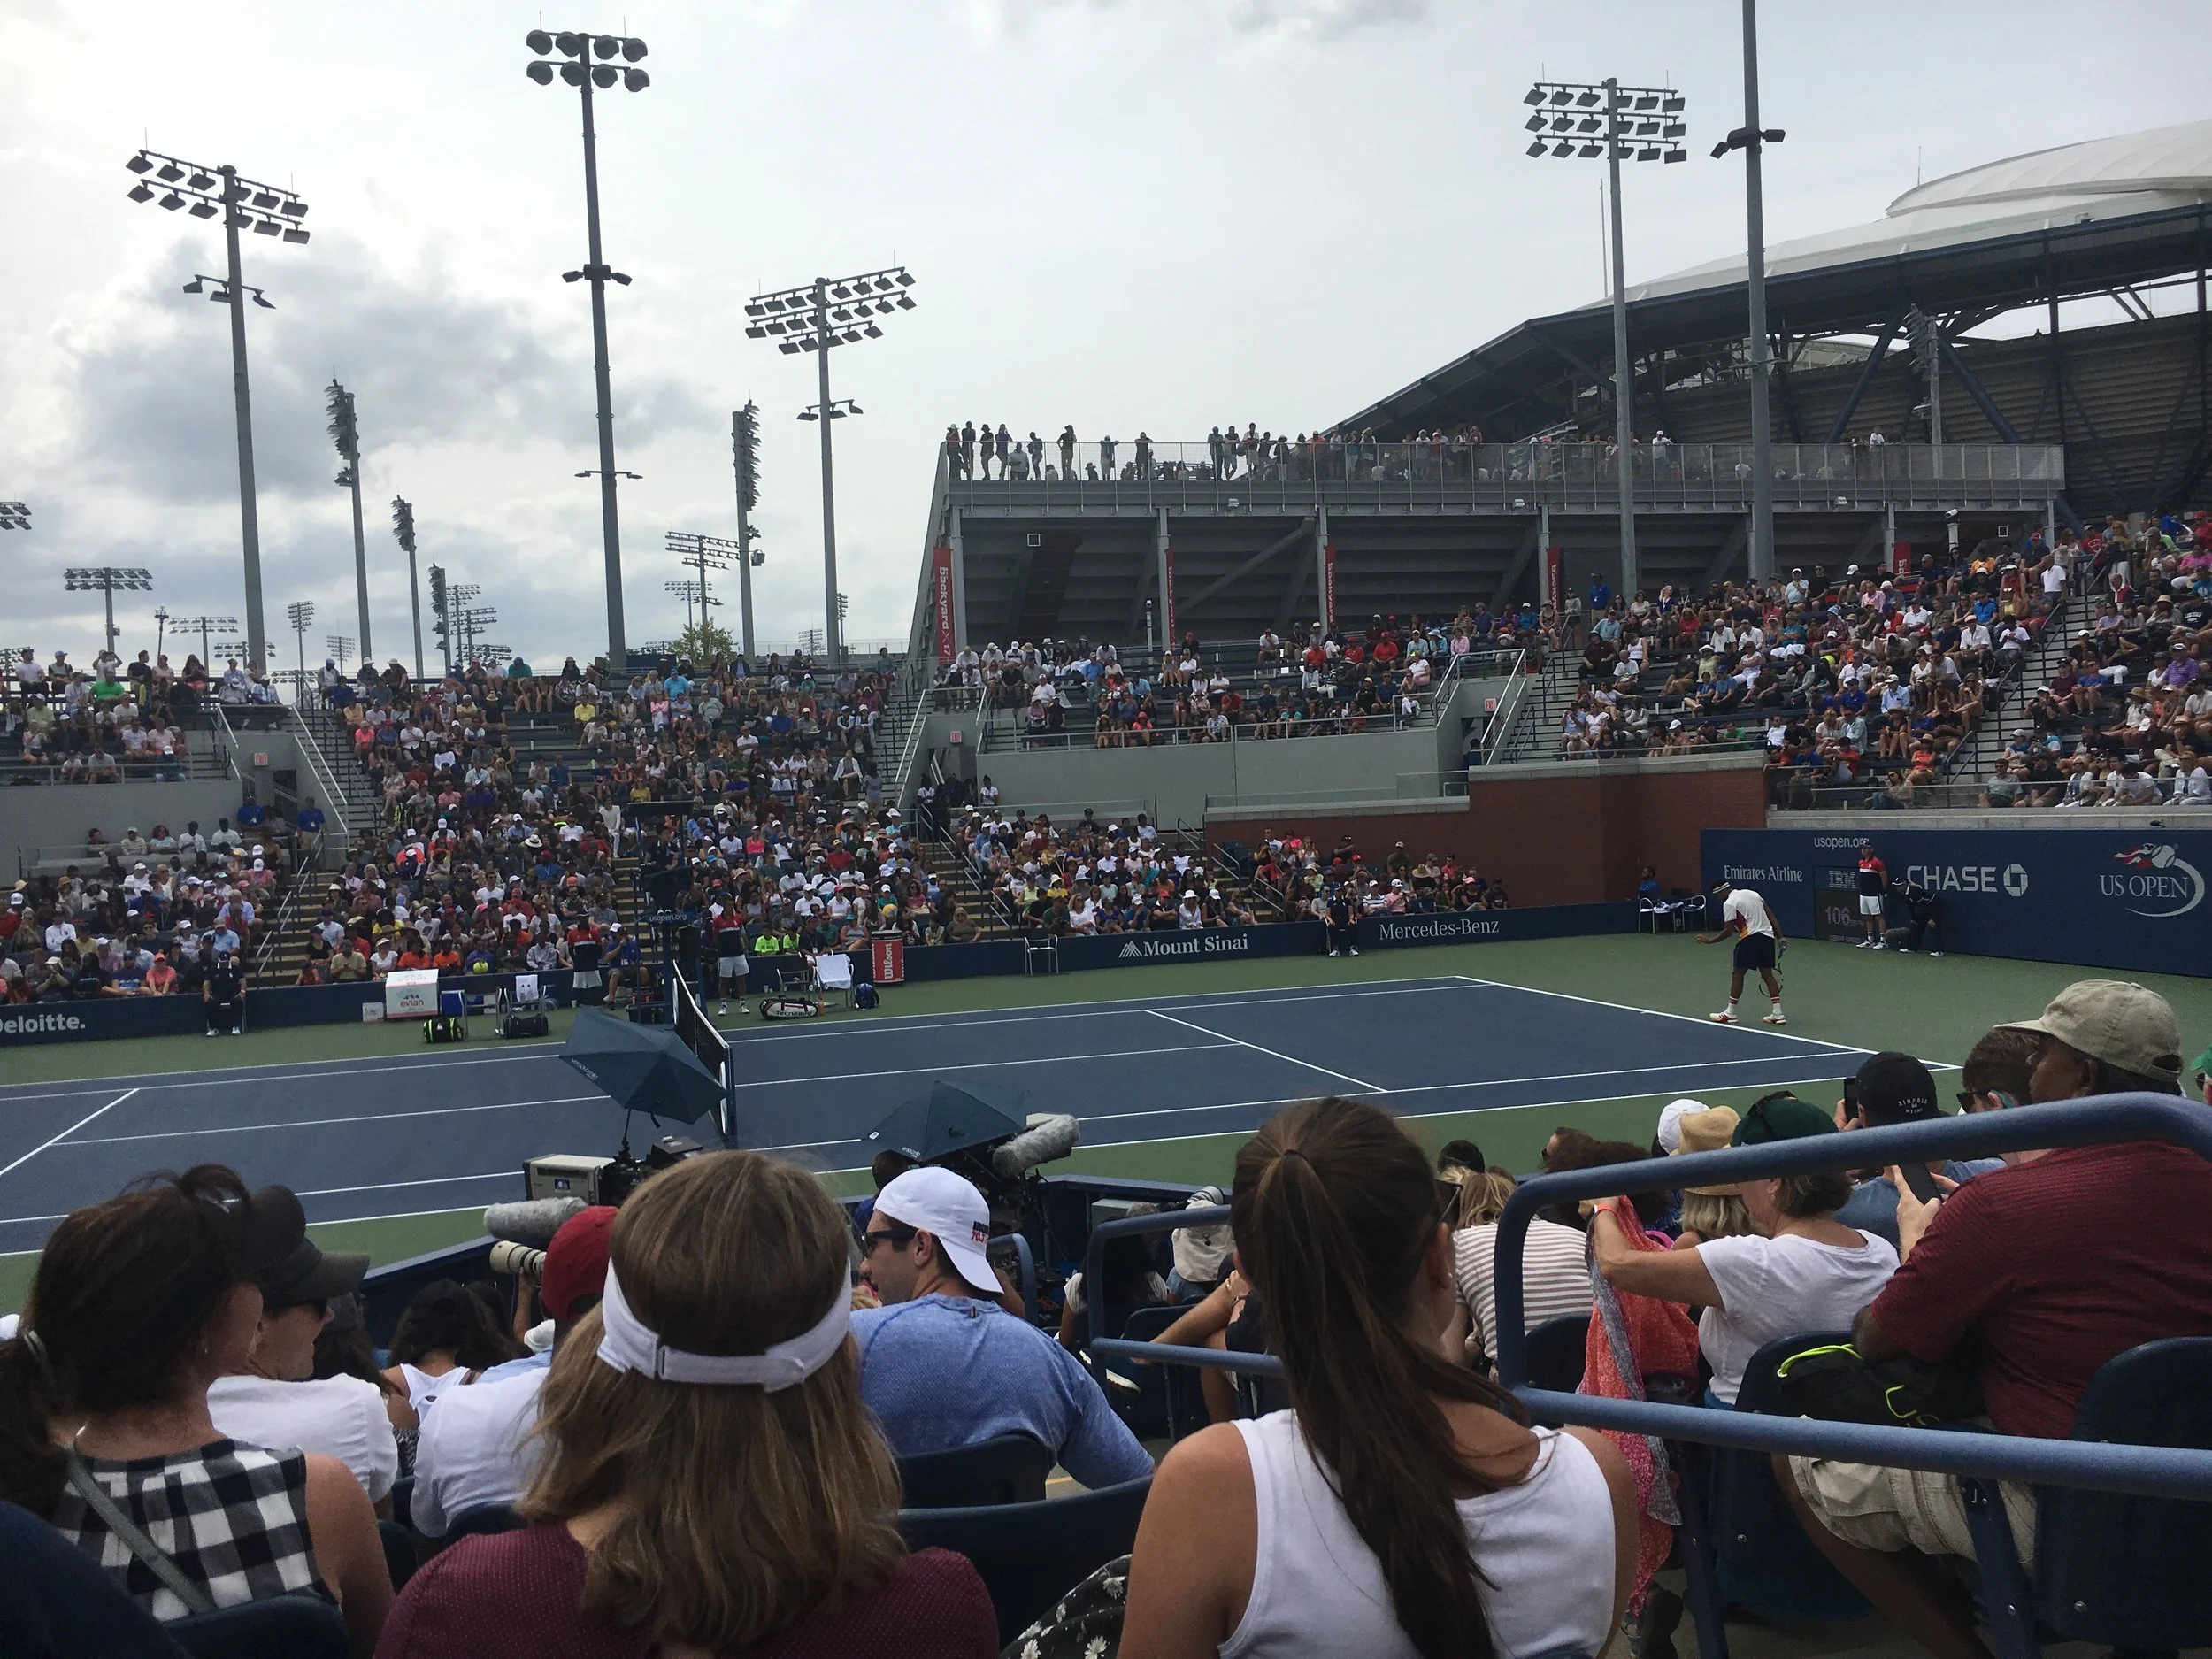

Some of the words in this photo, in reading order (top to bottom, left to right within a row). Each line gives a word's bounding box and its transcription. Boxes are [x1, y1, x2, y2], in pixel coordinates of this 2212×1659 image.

[939, 566, 949, 630] backyard
[943, 644, 951, 656] 17
[1724, 864, 1765, 880] Emirates
[1768, 866, 1803, 882] Airline
[1829, 870, 1857, 889] IBM
[2099, 874, 2124, 896] US
[2129, 875, 2189, 898] OPEN
[1824, 906, 1850, 926] 106
[1379, 918, 1500, 940] Mercedes-Benz
[1143, 938, 1201, 956] Mount
[1204, 933, 1248, 952] Sinai
[883, 942, 894, 979] Wilson
[400, 999, 424, 1008] evian
[0, 1013, 86, 1033] eloitte.
